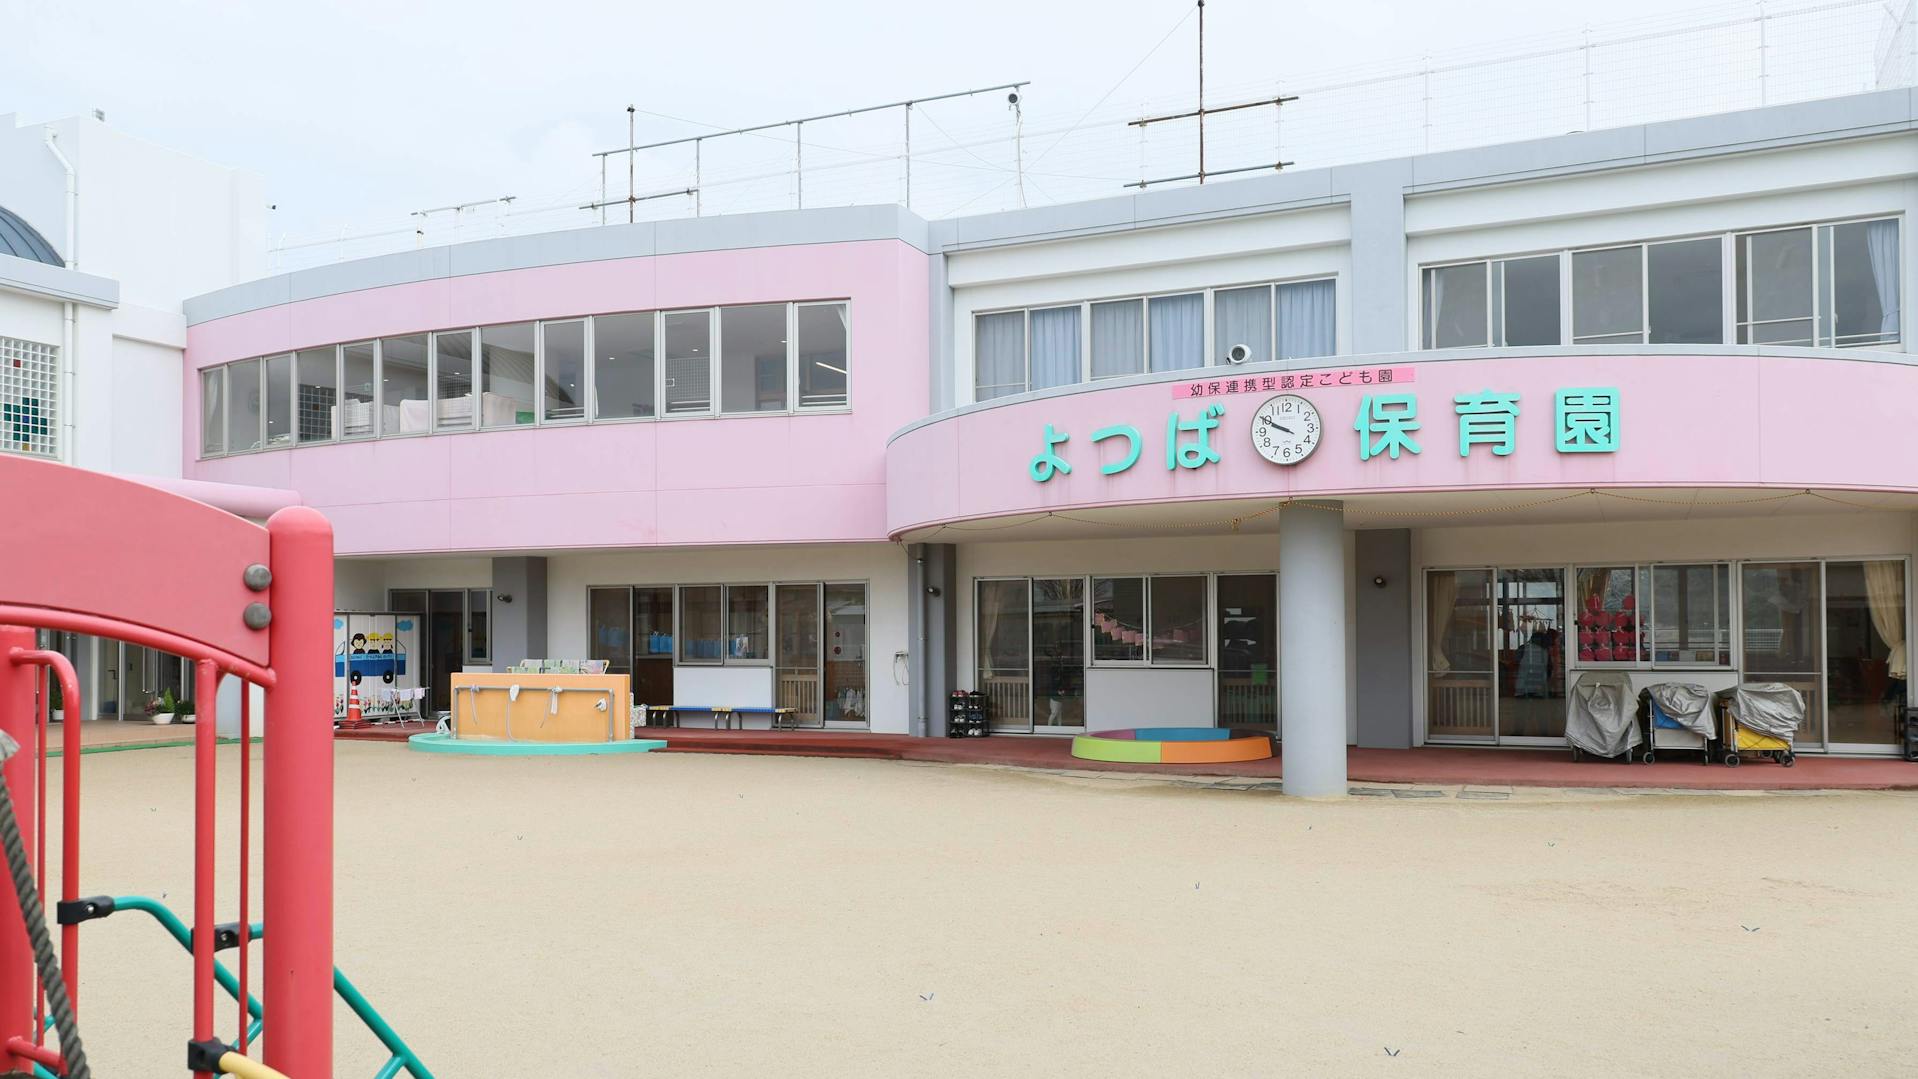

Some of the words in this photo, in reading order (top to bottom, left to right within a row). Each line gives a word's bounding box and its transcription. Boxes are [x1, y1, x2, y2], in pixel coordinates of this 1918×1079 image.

[1190, 369, 1393, 397] 幼保連携型認定こども園
[1281, 402, 1292, 413] 12
[1303, 411, 1311, 422] 2
[1259, 427, 1267, 437] 9
[1307, 422, 1315, 433] 3
[1029, 404, 1224, 481] よつば
[1355, 388, 1620, 459] 保育園
[1303, 434, 1311, 444] 4
[1263, 437, 1271, 447] 8
[1272, 445, 1280, 455] 7
[1283, 447, 1291, 458] 6
[1295, 443, 1303, 454] 5
